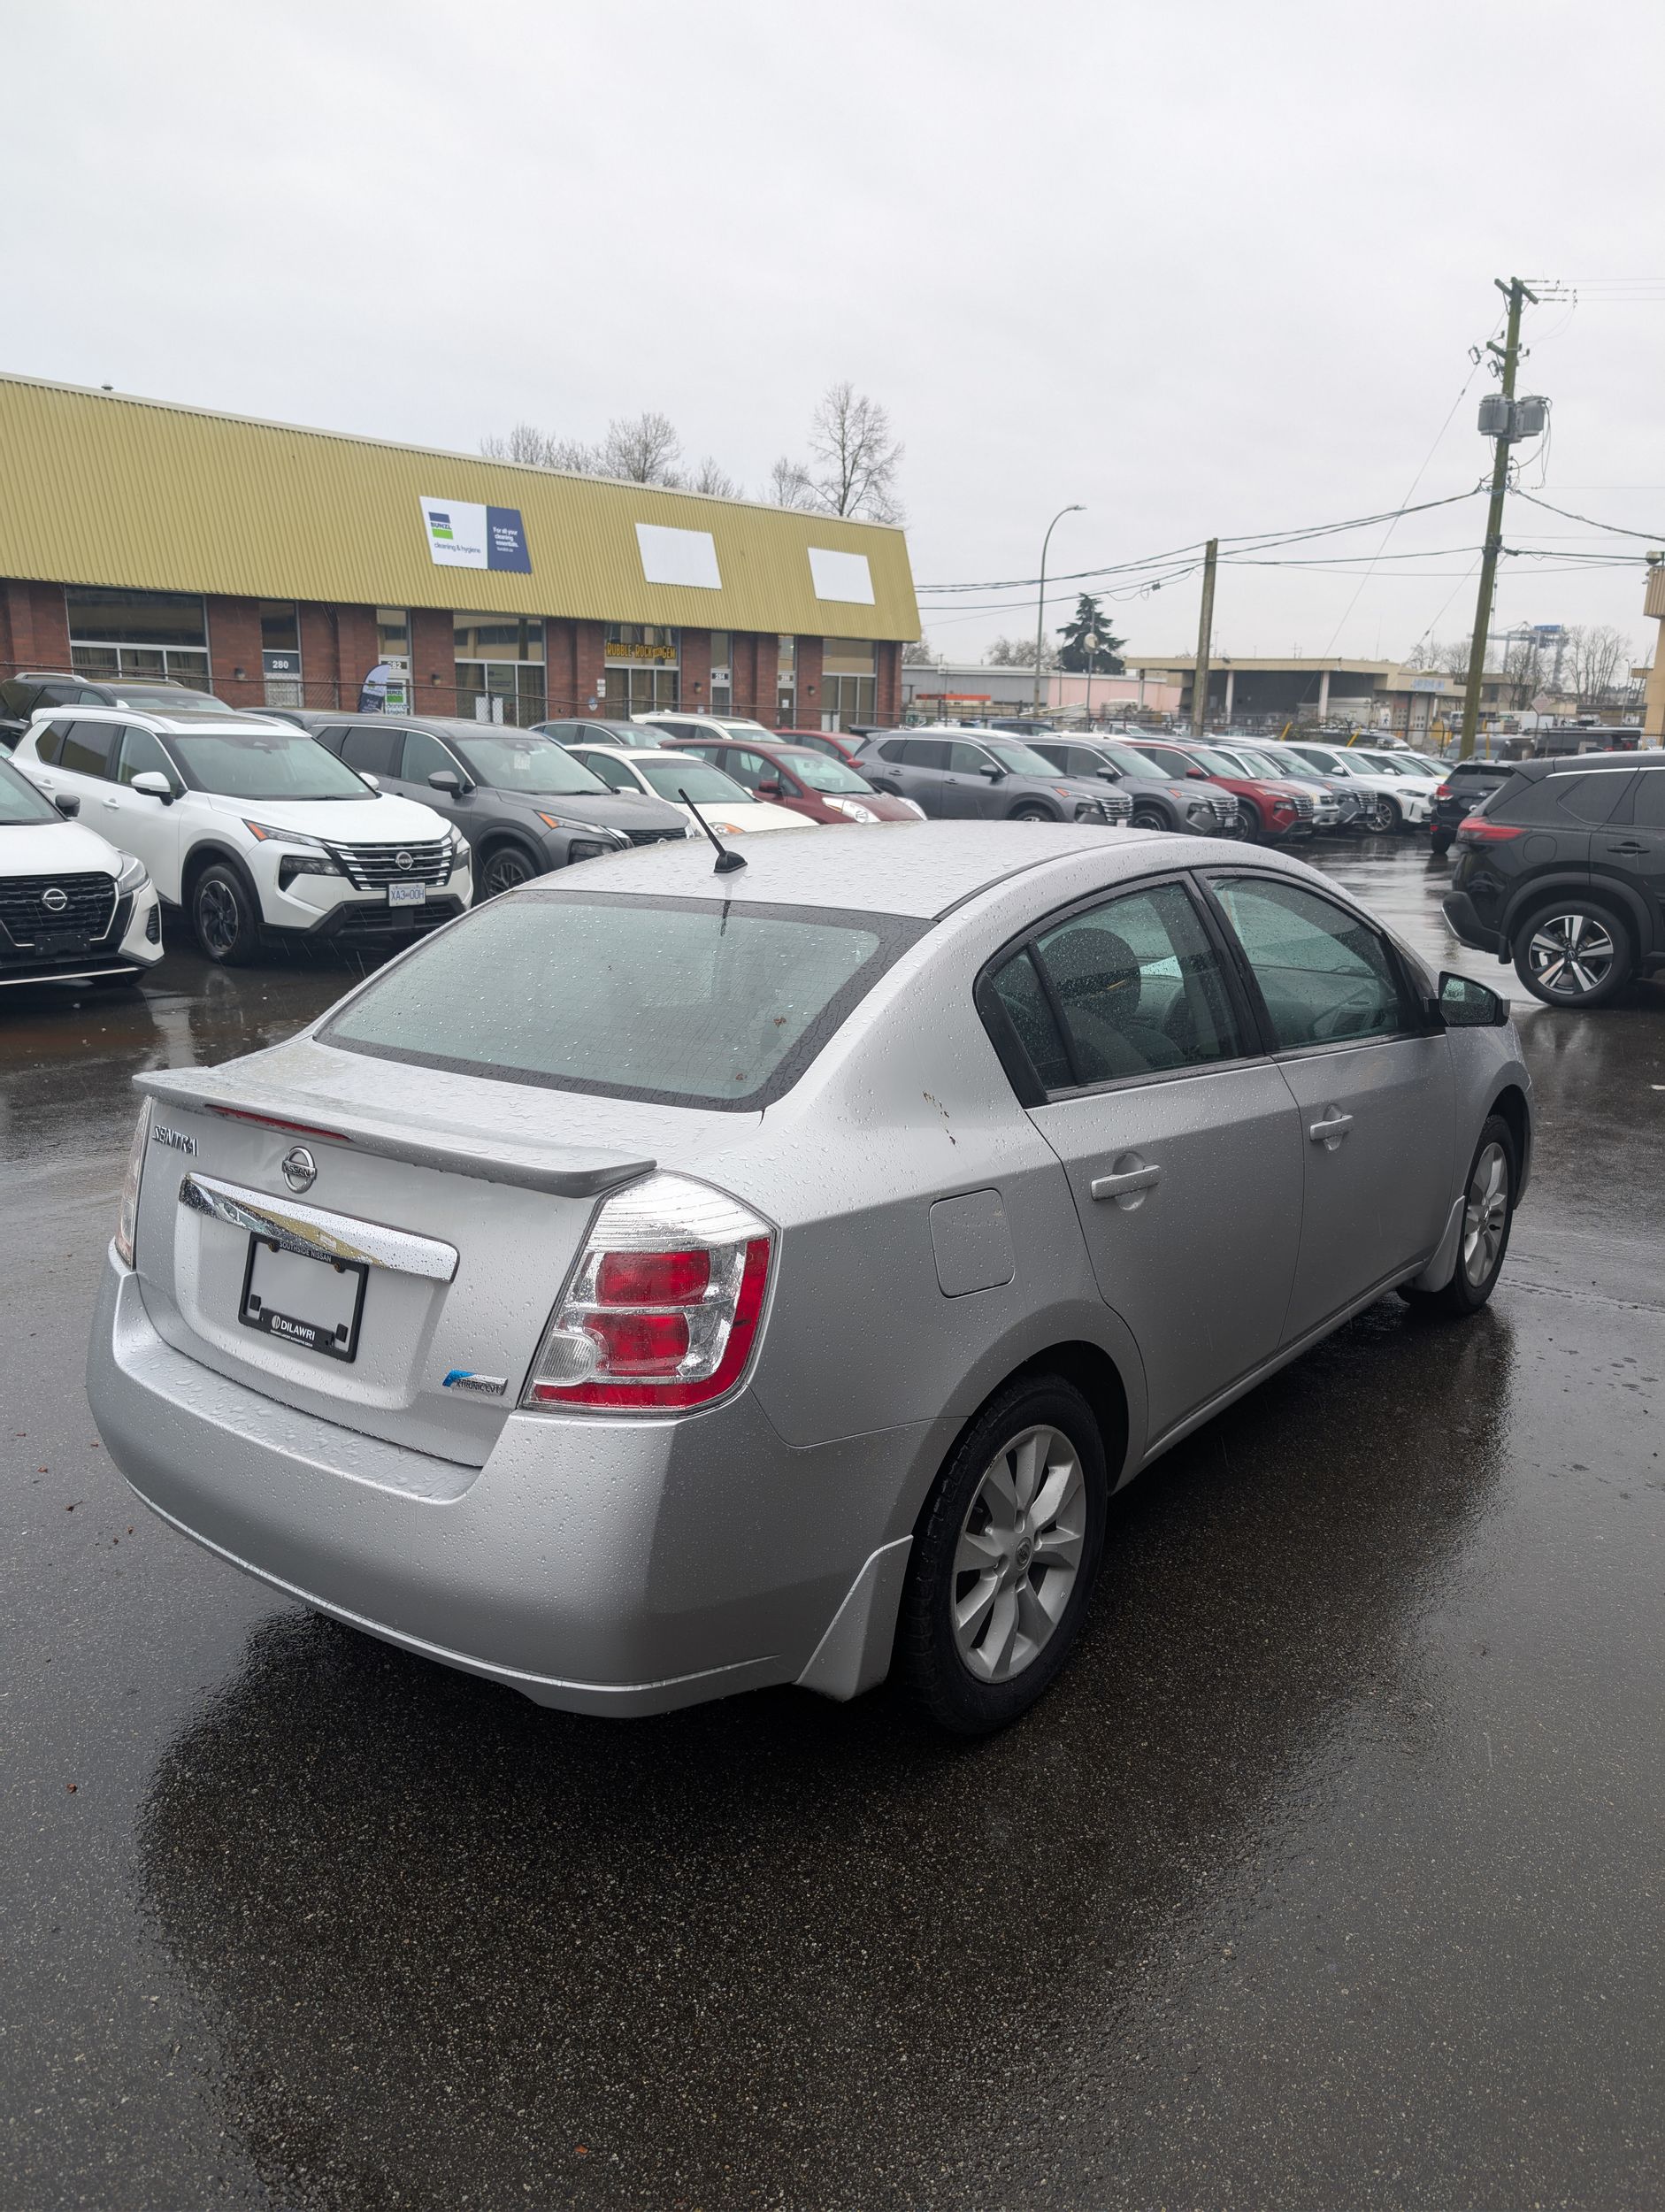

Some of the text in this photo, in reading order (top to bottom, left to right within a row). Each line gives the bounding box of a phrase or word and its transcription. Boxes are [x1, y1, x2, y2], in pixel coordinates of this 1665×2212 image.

[434, 541, 456, 552] cleaning
[461, 545, 481, 554] hygiene
[607, 642, 632, 657] RUBBLE
[635, 644, 653, 659] ROCK
[663, 645, 677, 659] GEM
[272, 660, 289, 669] 280
[152, 1125, 199, 1157] SENTRA
[284, 1163, 311, 1178] NISSAN
[280, 1240, 332, 1263] SOUTHSIDE NISSAN
[280, 1319, 316, 1340] DILAWRI
[457, 1380, 502, 1394] XTRONIC CVT
